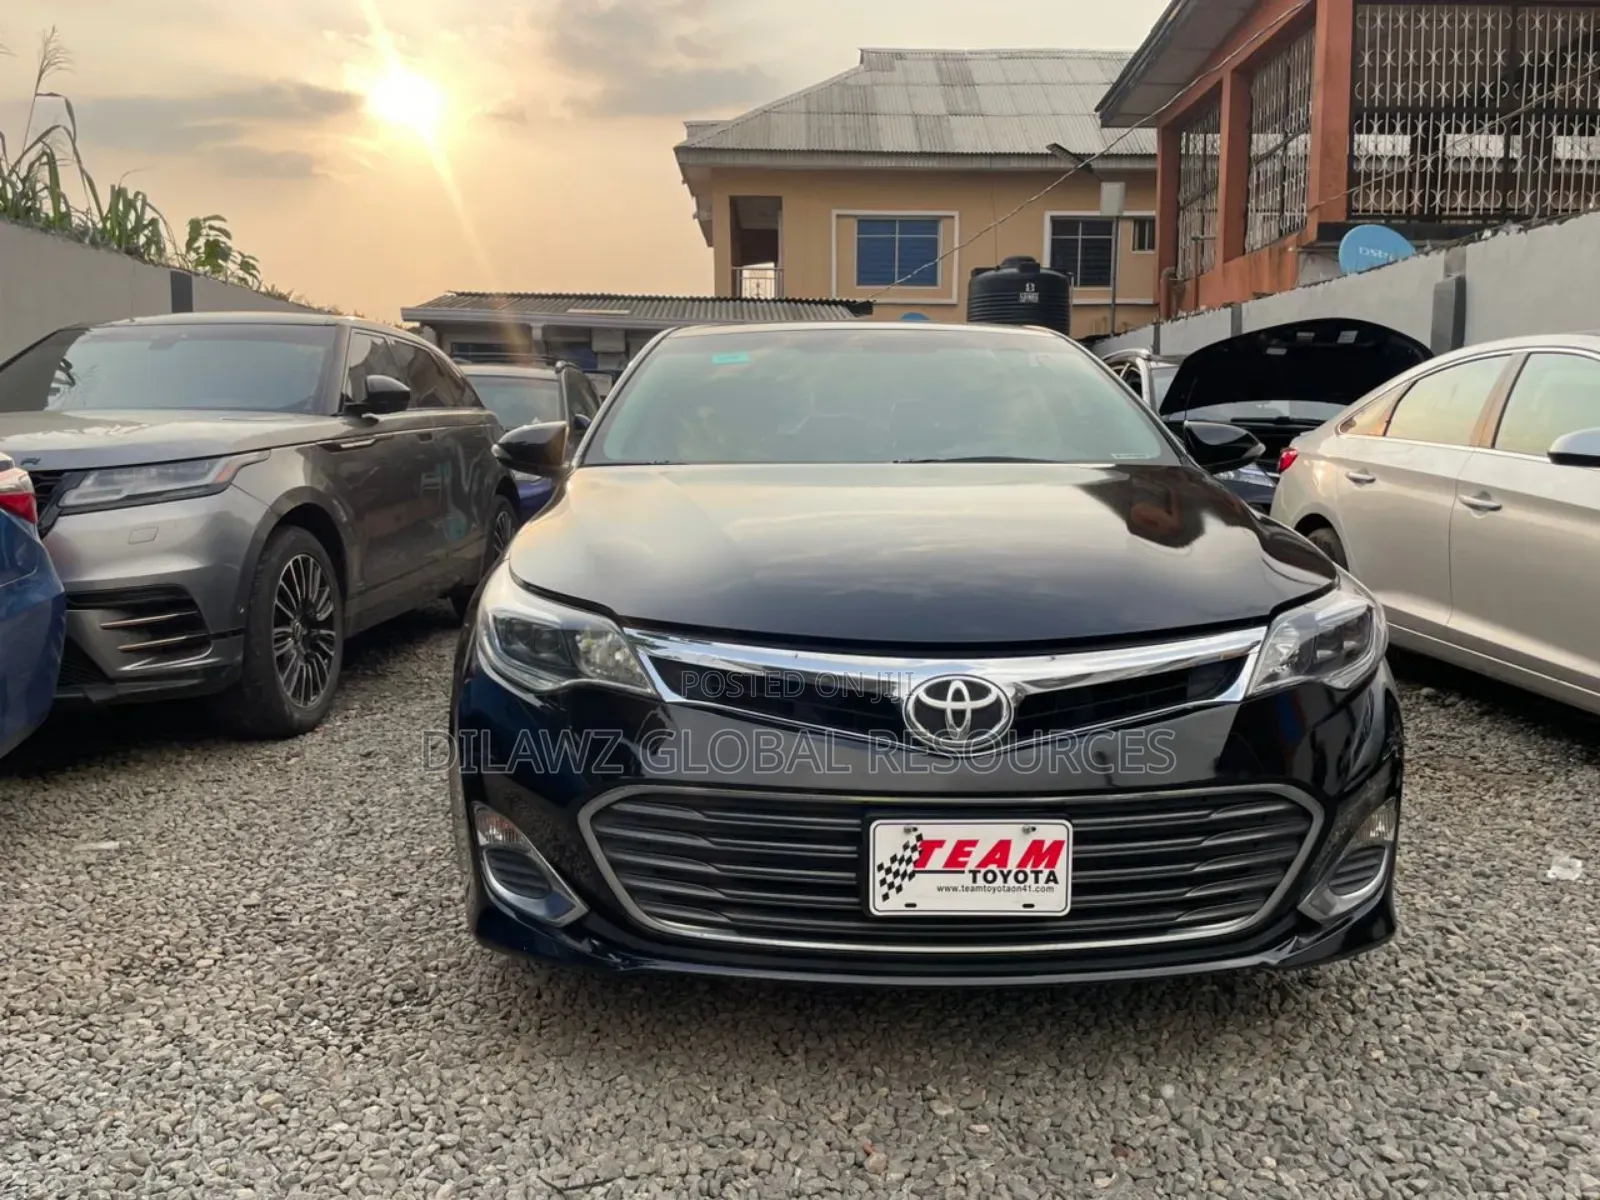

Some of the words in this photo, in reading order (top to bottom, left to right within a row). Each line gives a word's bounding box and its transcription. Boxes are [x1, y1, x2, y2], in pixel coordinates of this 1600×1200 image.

[913, 839, 1066, 869] TEAM
[969, 869, 1059, 885] TOYOTA
[936, 884, 1055, 894] www.teamtoyotaon41.com
